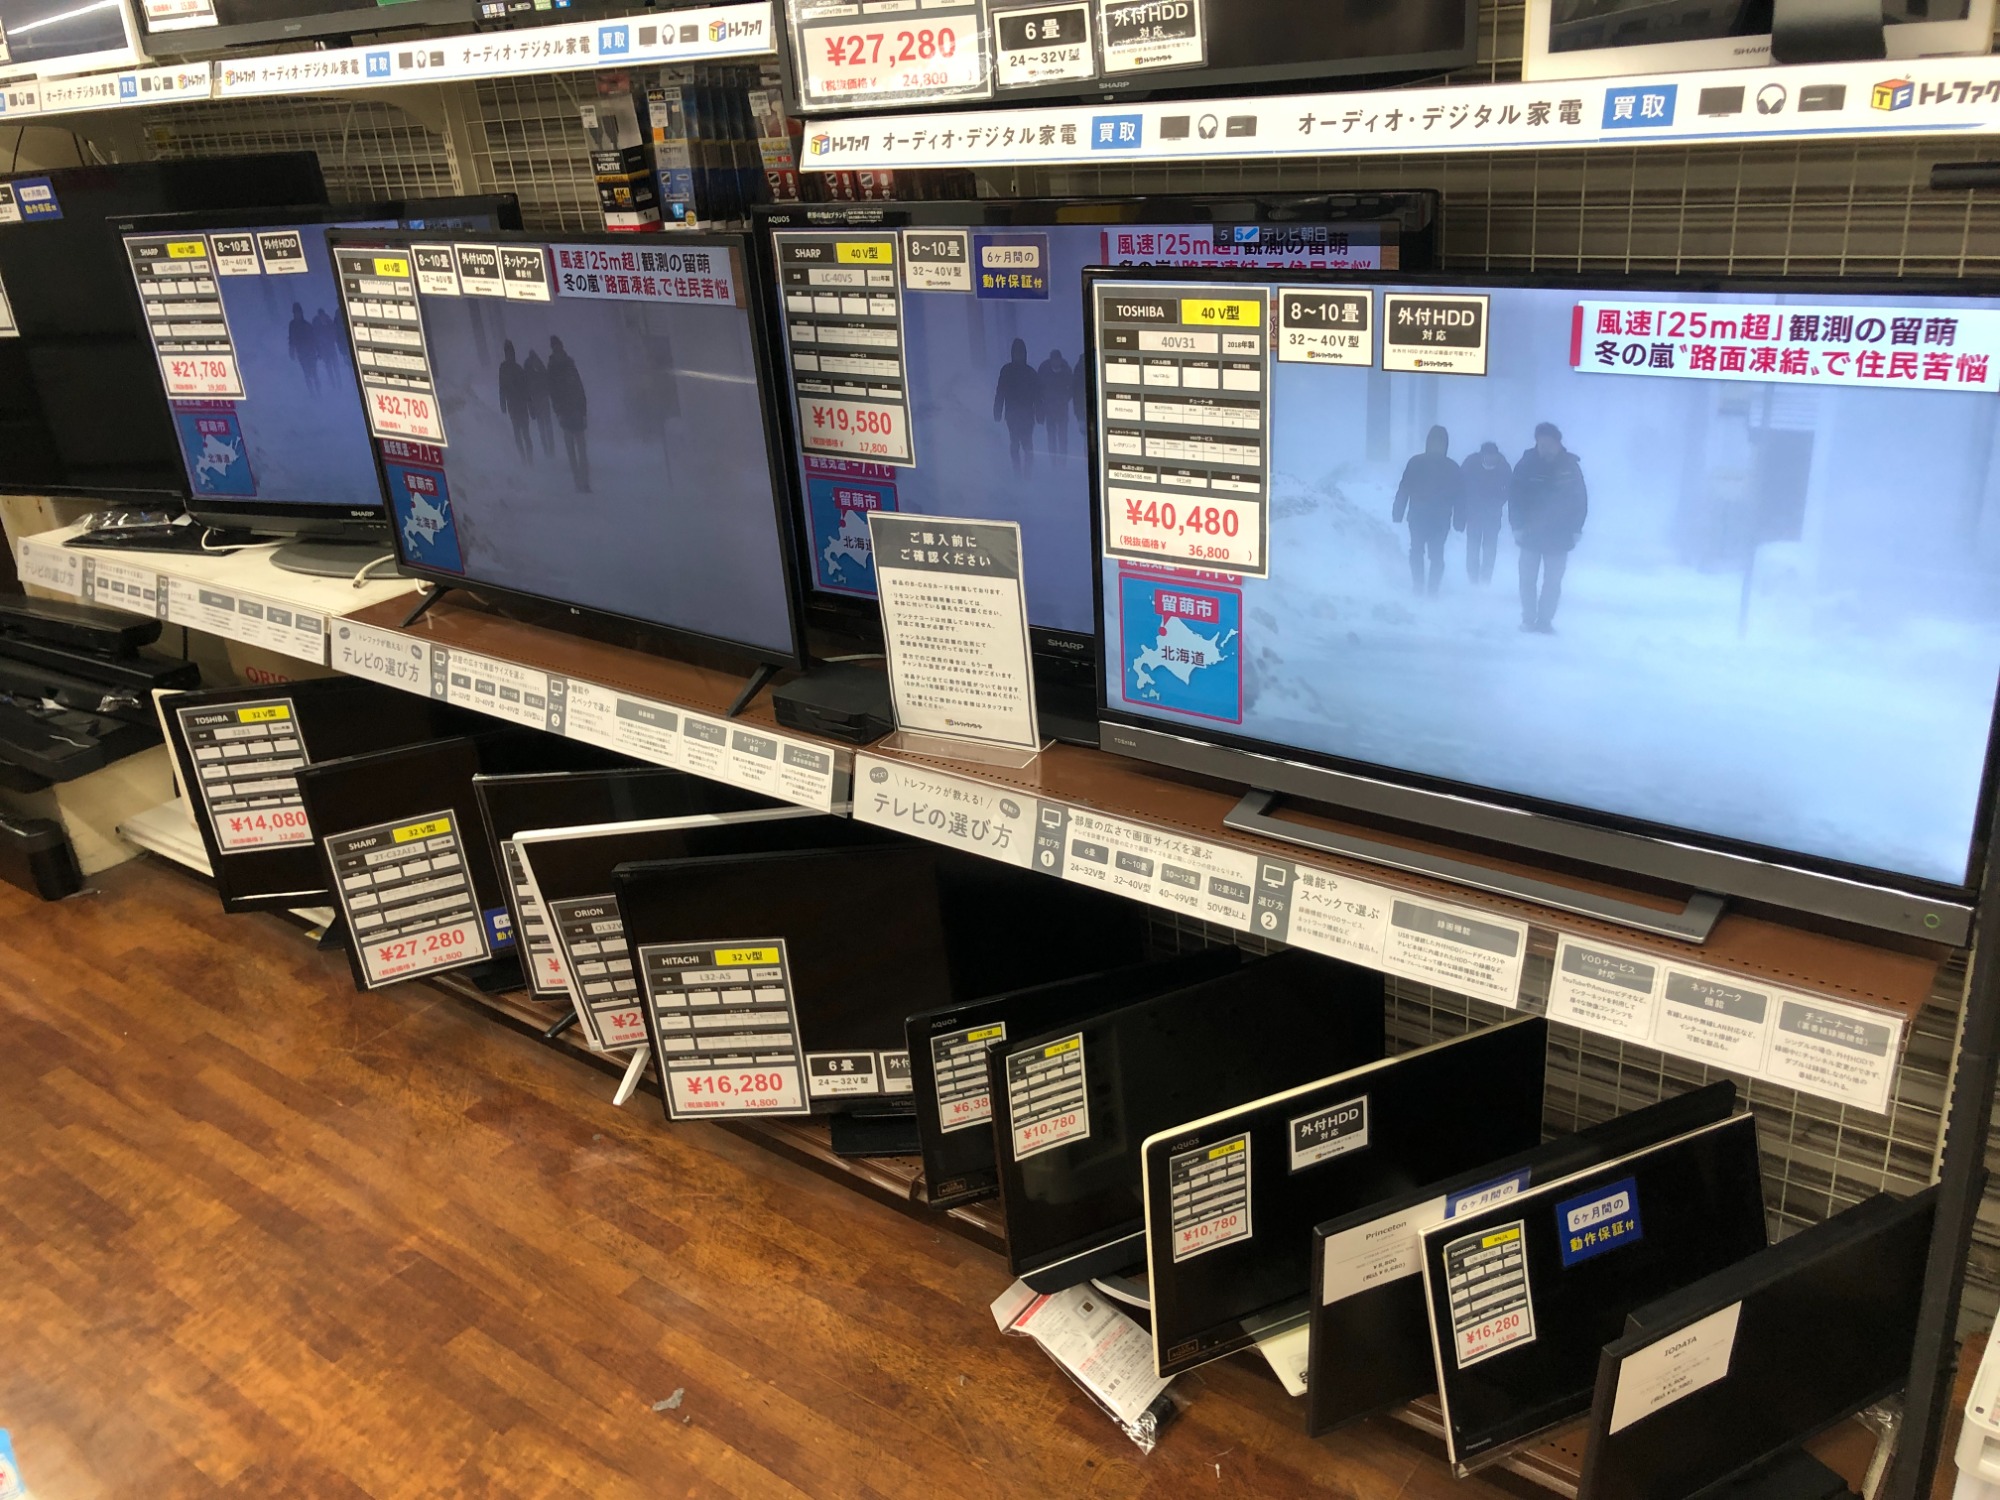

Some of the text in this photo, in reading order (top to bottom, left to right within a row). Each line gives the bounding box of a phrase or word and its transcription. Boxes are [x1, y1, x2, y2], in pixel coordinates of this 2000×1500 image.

[728, 20, 763, 37] トレファク
[463, 31, 625, 64] オーディオ・デジタル家電 買取
[825, 28, 956, 67] ¥27,280
[369, 57, 388, 73] 買取
[121, 79, 136, 95] 買取
[903, 72, 948, 87] 24,800
[1299, 94, 1666, 135] オーディオ・デジタル家電 買取
[832, 136, 869, 151] トレファク
[882, 121, 1135, 151] オーディオ・デジタル家電 買取
[596, 163, 620, 171] HDMI
[795, 248, 821, 258] SHARP
[912, 241, 960, 257] 8～10畳
[418, 254, 450, 268] 8～10畳
[461, 253, 495, 266] 外付HDD
[504, 256, 540, 269] ネットワーク
[982, 274, 1043, 289] 動作保証付
[1117, 305, 1165, 318] TOSHIBA
[1201, 305, 1240, 321] 40 V型
[1290, 302, 1360, 324] 8～10畳
[1397, 307, 1475, 327] 外付HDD
[1422, 329, 1448, 342] 対応
[1596, 309, 1959, 347] 風速「25m超」観測の留萌
[1161, 336, 1196, 349] 40V31
[1289, 334, 1360, 349] 32～40V型
[171, 361, 227, 381] ¥21,780
[376, 394, 429, 420] ¥32,780
[812, 406, 892, 435] ¥19,580
[859, 442, 888, 454] 17,800
[839, 491, 877, 509] 留萌市
[351, 510, 374, 518] SHARP
[1126, 498, 1239, 538] ¥40,480
[910, 532, 977, 548] ご購入前に
[900, 549, 991, 567] ご確認ください
[1188, 544, 1230, 560] 36,800
[1161, 594, 1213, 618] 留萌市
[1047, 638, 1084, 651] SHARP
[1161, 645, 1205, 667] 北海道
[343, 647, 420, 683] テレビの選び方
[194, 715, 229, 726] TOSHIBA
[1114, 737, 1137, 747] TOSHIBA
[230, 811, 307, 832] ¥14,080
[874, 793, 1013, 849] テレビの選び方
[349, 838, 377, 850] SHARP
[1038, 836, 1060, 849] 選び方
[1075, 815, 1212, 860] 部屋の広さで画面サイズを選ぶ
[1070, 862, 1106, 880] 24～32V型
[1121, 857, 1148, 872] 8～10畳
[1113, 875, 1151, 893] 32～40V型
[1213, 882, 1245, 898] 12畳以上
[1302, 873, 1338, 891] 機能や
[1159, 888, 1198, 907] 40～49V型
[1258, 896, 1284, 911] 選び方
[1301, 889, 1380, 920] スペックで選ぶ
[574, 907, 604, 918] ORION
[1207, 902, 1247, 921] 50V型以上
[379, 930, 465, 962] ¥27,280
[662, 956, 699, 966] HITACHI
[732, 951, 763, 961] 32 V型
[1581, 952, 1636, 975] VODサービス
[1598, 968, 1617, 980] 対応
[1690, 982, 1742, 1003] ネットワーク
[1704, 997, 1725, 1010] 機能
[931, 1018, 957, 1029] AQUOS
[1805, 1012, 1865, 1036] チューナー数
[687, 1073, 783, 1096] ¥16,280
[745, 1098, 778, 1108] 14,800
[953, 1096, 989, 1114] ¥6,38
[1024, 1114, 1076, 1140] ¥10,780
[1300, 1108, 1359, 1138] 外付HDD
[1320, 1128, 1340, 1140] 対応
[1171, 1137, 1200, 1151] AQUOS
[1573, 1198, 1625, 1226] 6ヶ月間の
[1183, 1215, 1237, 1242] ¥10,780
[1365, 1221, 1407, 1240] Princeton
[1569, 1219, 1635, 1253] 動作保証付
[1450, 1243, 1477, 1258] Panasonic
[1466, 1314, 1519, 1344] ¥16,280
